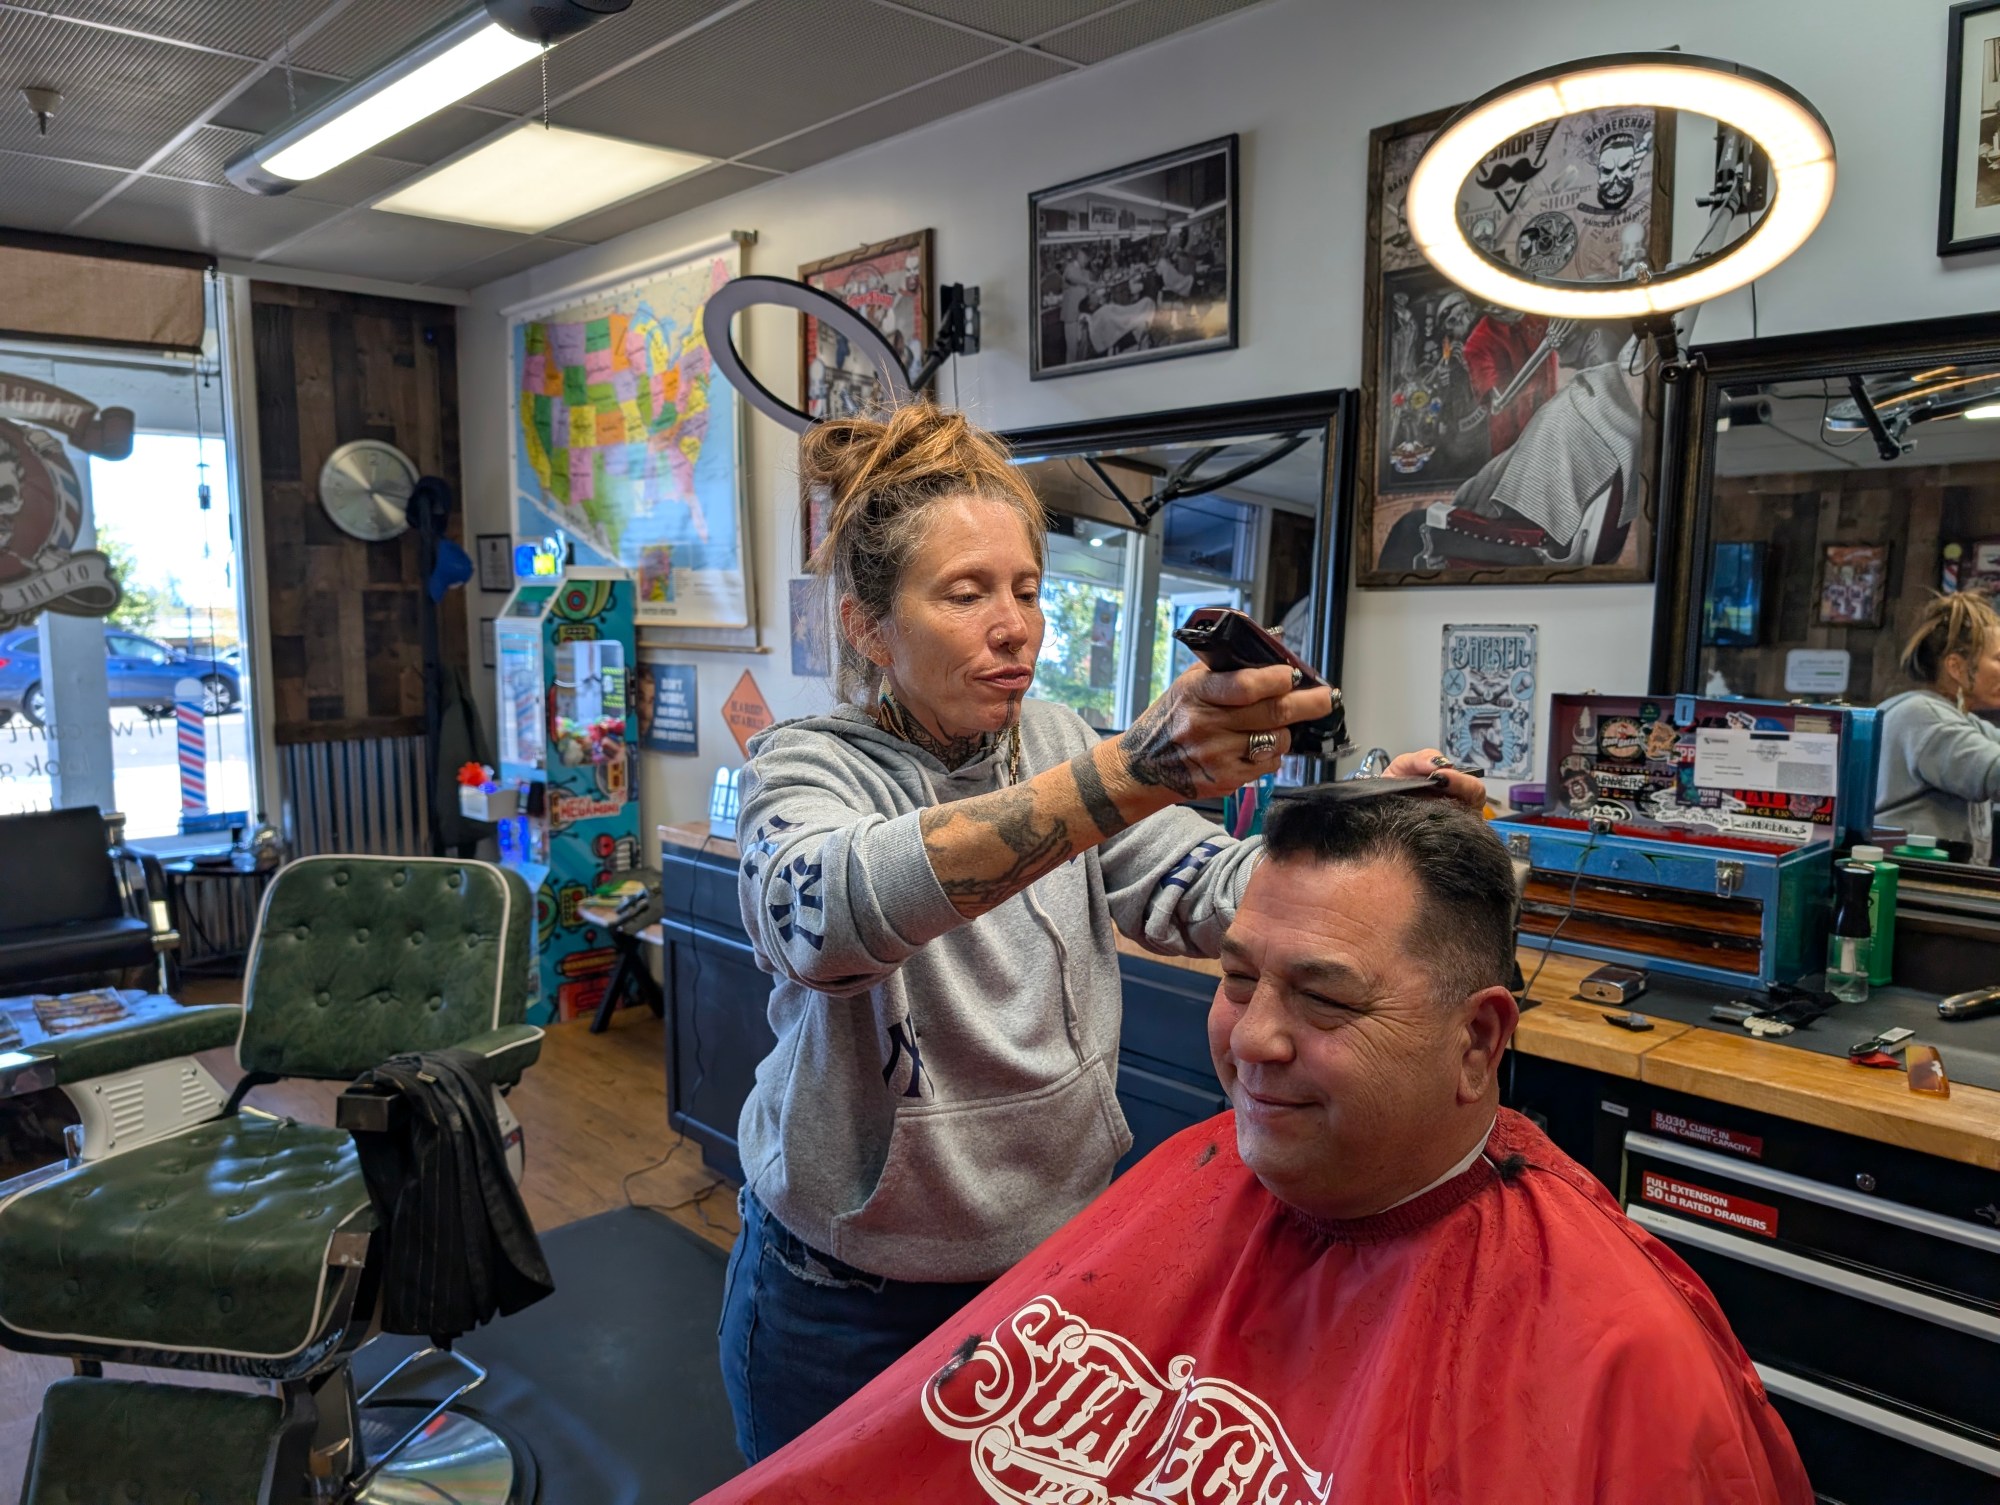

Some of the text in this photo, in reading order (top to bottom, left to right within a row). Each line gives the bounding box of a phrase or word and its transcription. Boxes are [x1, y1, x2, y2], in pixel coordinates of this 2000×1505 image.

[1656, 1122, 1678, 1135] TOTAL
[1679, 1127, 1712, 1143] CABINET
[1713, 1137, 1752, 1154] CAPACITY
[1689, 1123, 1716, 1136] CUBIC
[1719, 1130, 1730, 1141] IN
[1646, 1176, 1728, 1207] FULL EXTENSION
[1646, 1185, 1767, 1231] 50 LB RATED DRAWERS
